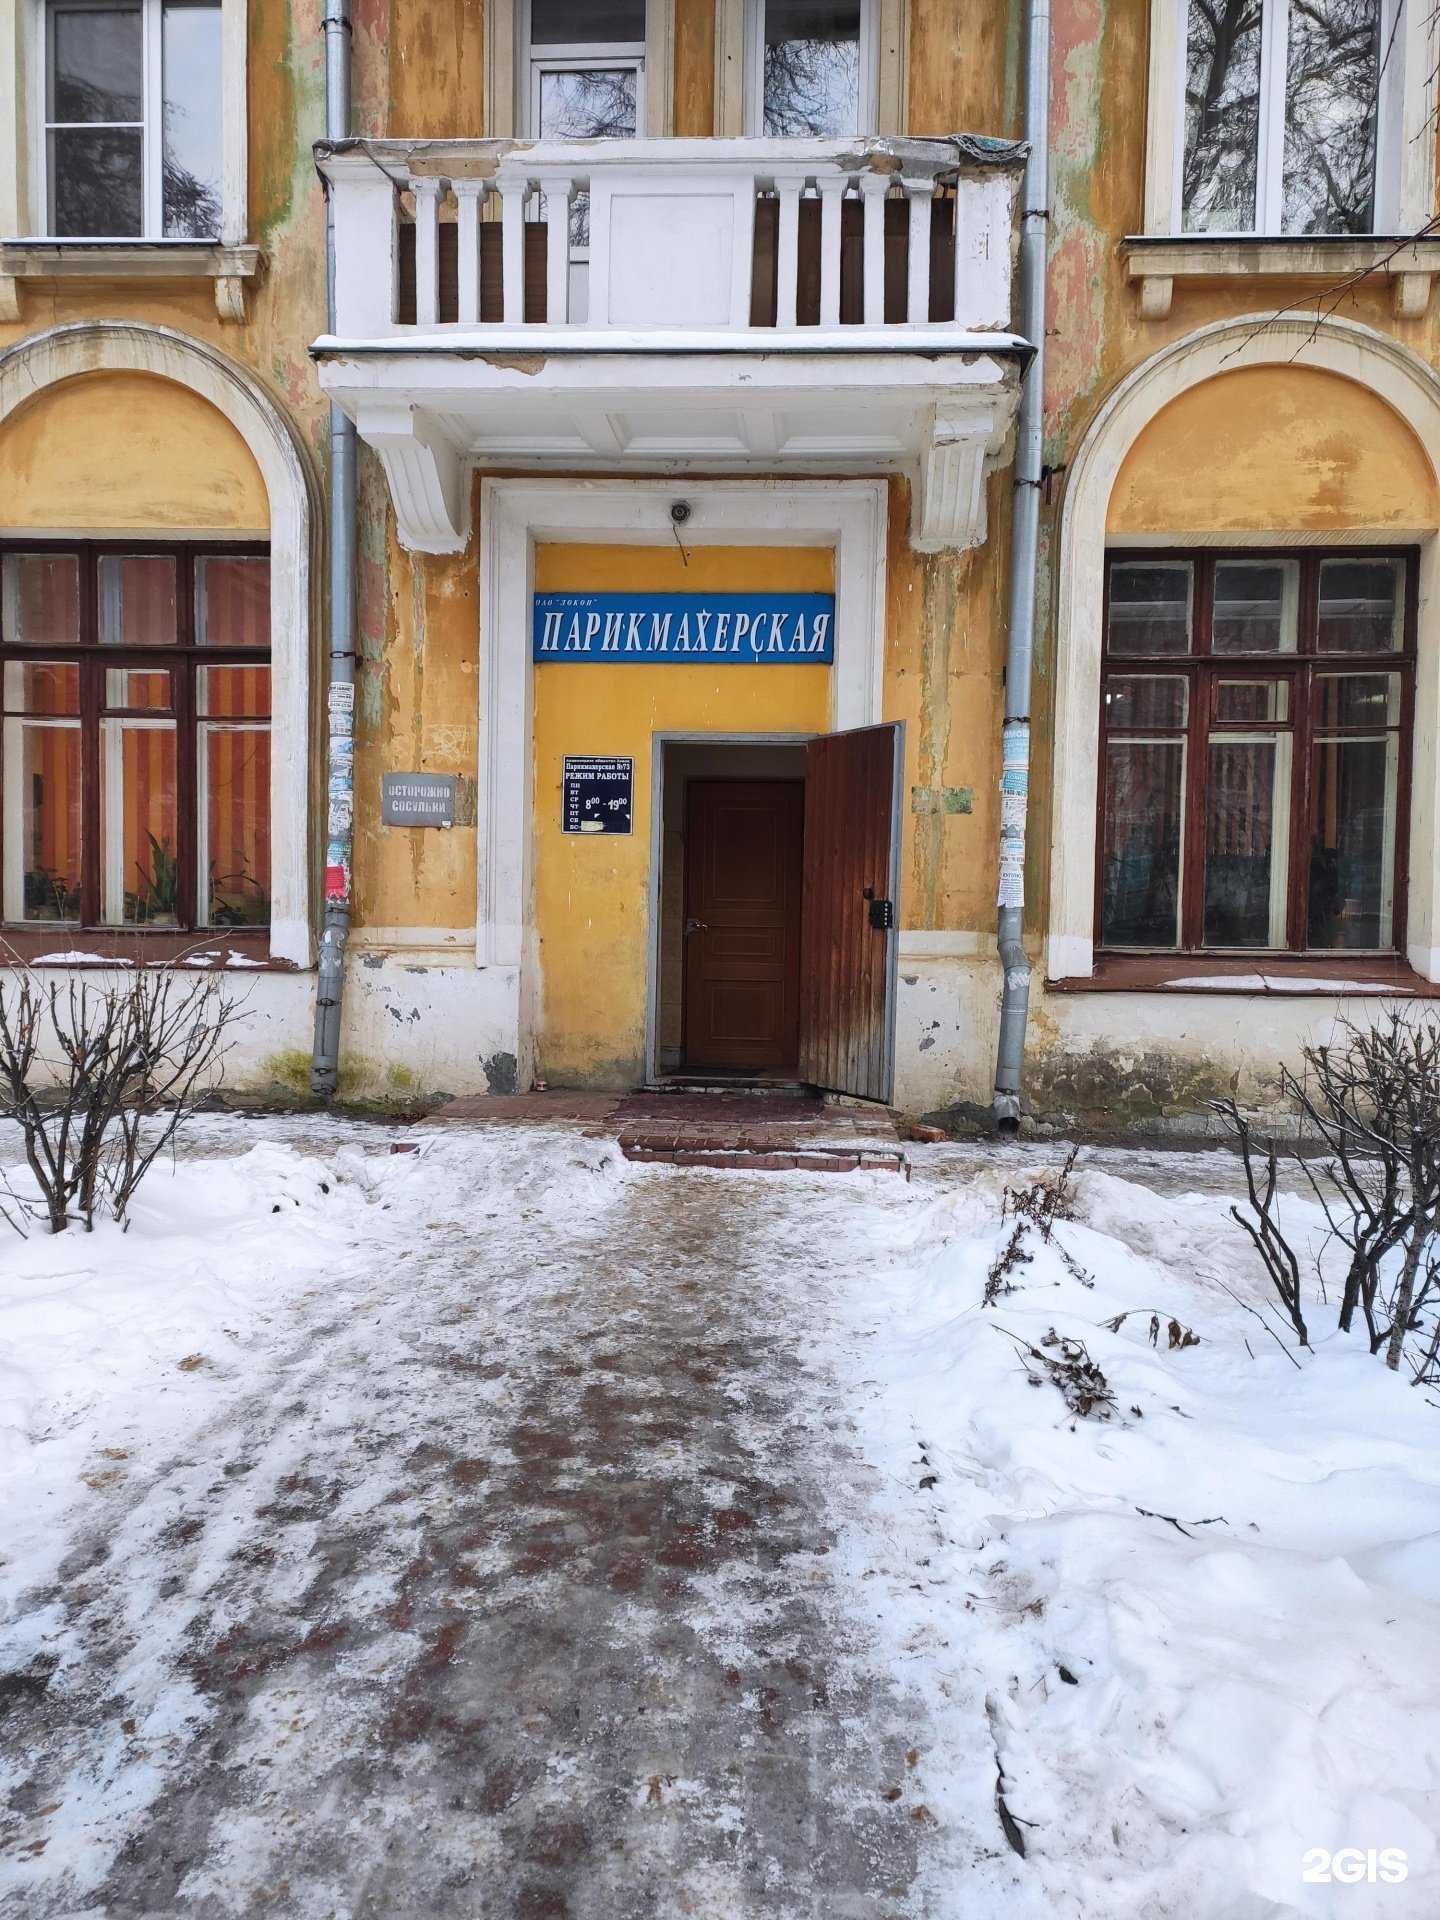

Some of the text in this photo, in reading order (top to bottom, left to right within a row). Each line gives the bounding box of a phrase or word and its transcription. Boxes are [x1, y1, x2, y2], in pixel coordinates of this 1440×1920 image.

[540, 611, 831, 652] ПАРИКМАХЕРСКАЯ
[566, 763, 616, 771] Парикмахерская
[565, 772, 629, 780] РЕЖИМ РАБОТЫ
[388, 785, 450, 798] ОСТОРОЖНО
[392, 800, 446, 813] СОСУЛЬКИ
